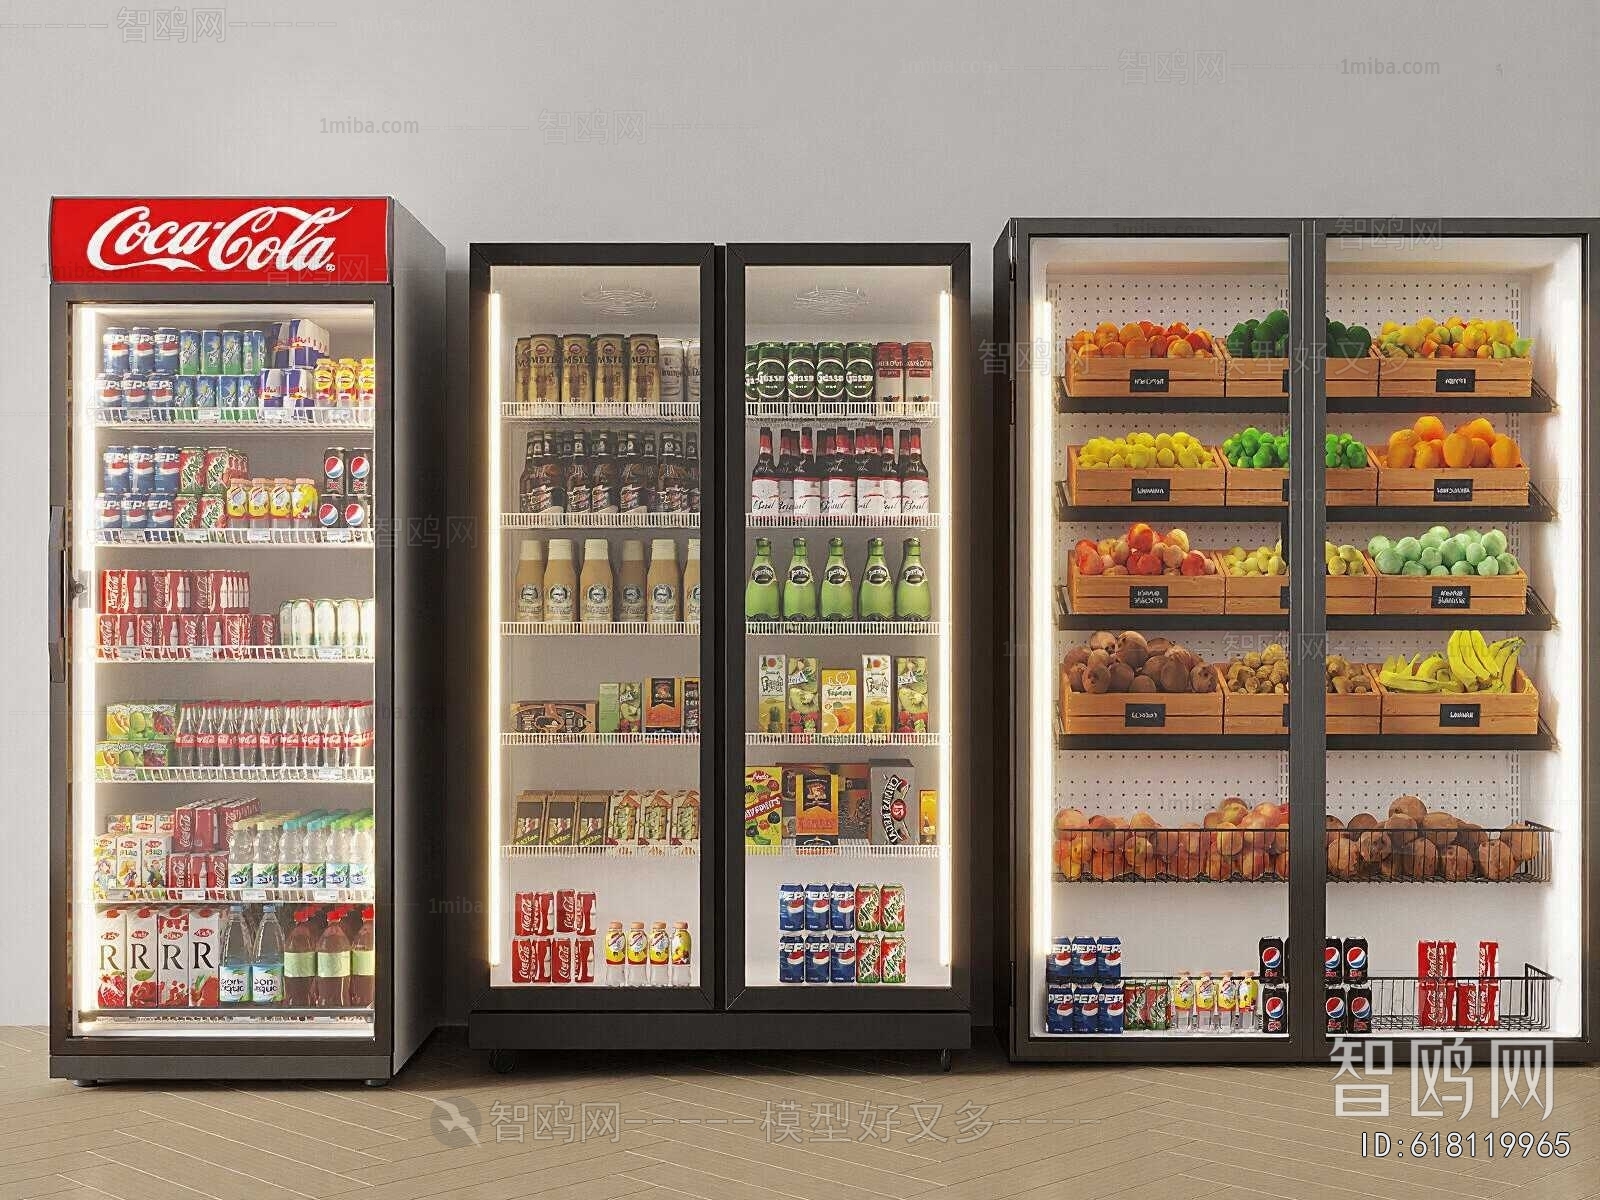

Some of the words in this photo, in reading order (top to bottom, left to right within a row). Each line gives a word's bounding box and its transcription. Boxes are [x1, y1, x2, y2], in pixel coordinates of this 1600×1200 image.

[86, 205, 352, 271] Coca-Cola
[100, 944, 121, 970] R
[131, 943, 151, 970] R
[163, 944, 184, 970] R
[193, 941, 214, 969] R
